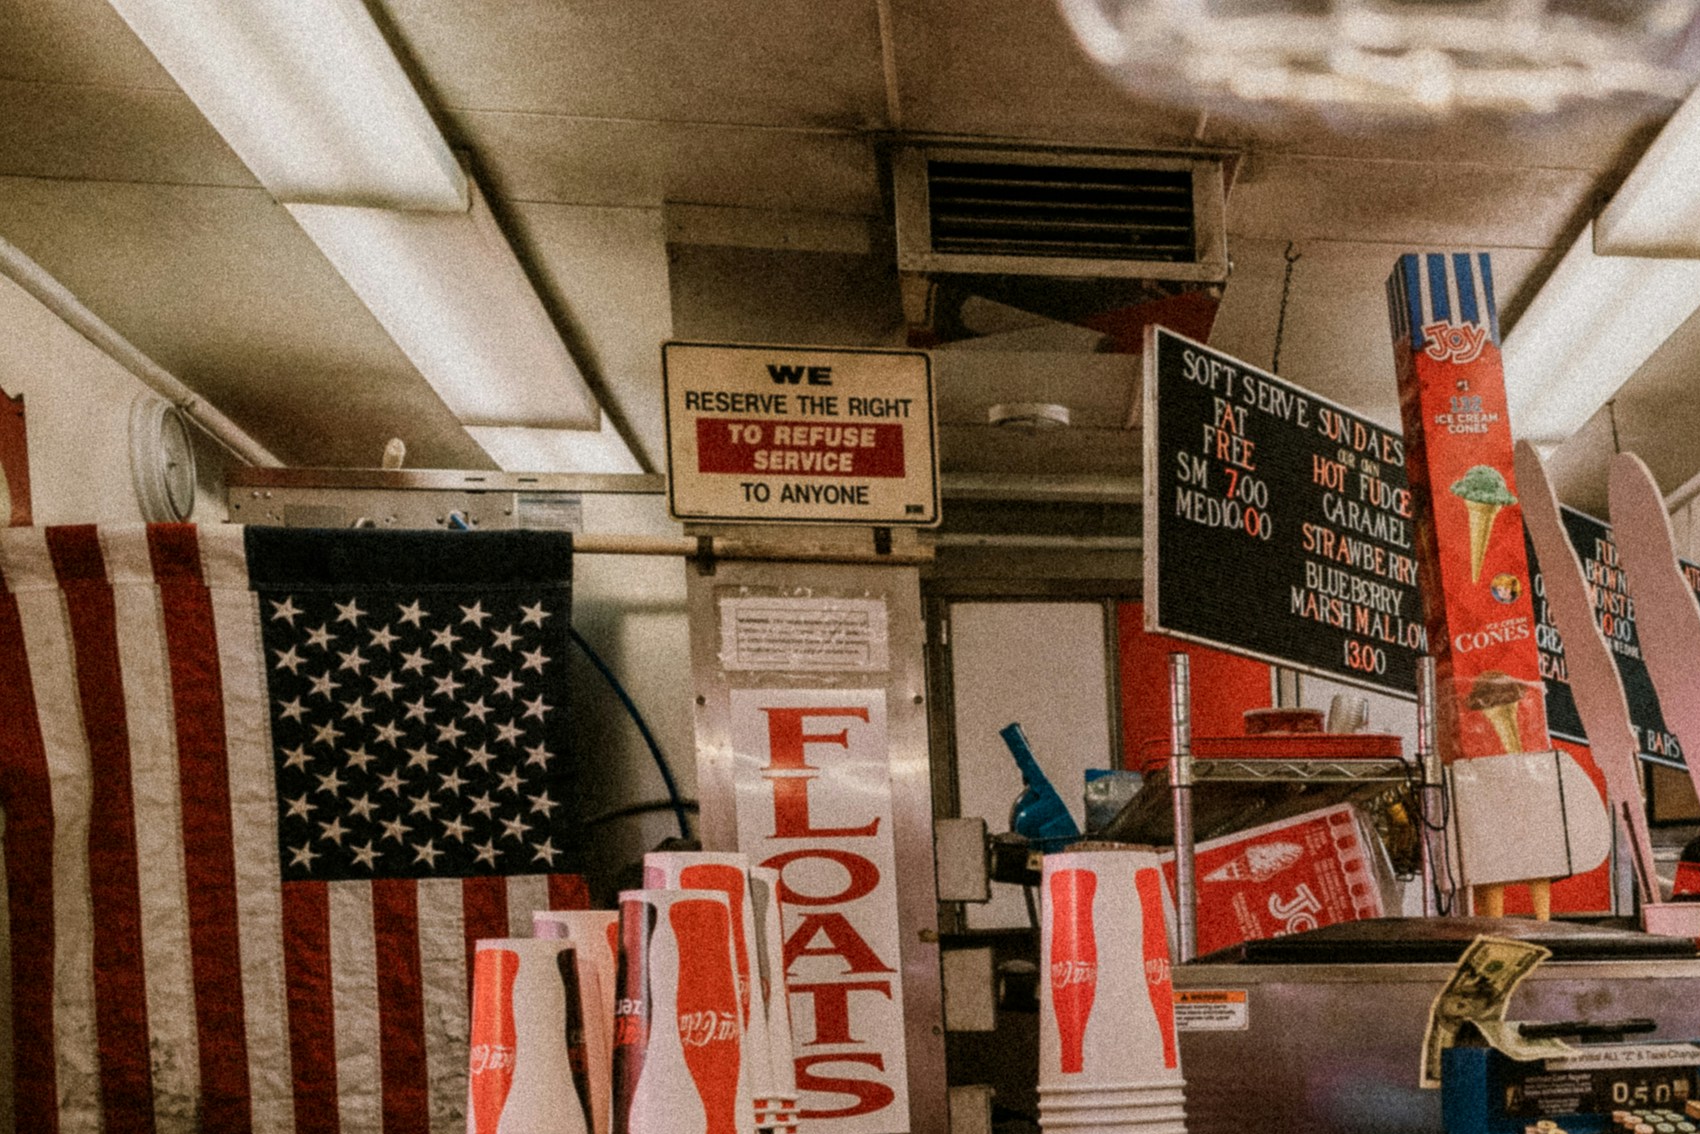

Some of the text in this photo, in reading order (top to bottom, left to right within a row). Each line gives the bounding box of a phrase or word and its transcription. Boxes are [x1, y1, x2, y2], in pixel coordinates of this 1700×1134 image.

[766, 364, 832, 385] WE
[685, 391, 912, 418] RESERVE THE RIGHT
[1182, 350, 1404, 468] SOFT SERVE SUNDAES
[1214, 397, 1248, 435] FAT
[1435, 412, 1498, 424] ICE CREAM
[727, 423, 876, 448] TO REFUSE
[1448, 423, 1488, 433] CONES
[753, 450, 853, 472] SERVICE
[1203, 424, 1256, 471] FREE
[1177, 451, 1268, 509] SM 7.00
[1313, 454, 1347, 493] HOT
[740, 482, 869, 505] TO ANYONE
[1323, 492, 1411, 549] CARAMEL
[1302, 522, 1418, 587] STRAWBERRY
[1455, 624, 1529, 653] CONES
[757, 707, 898, 1120] FLOATS
